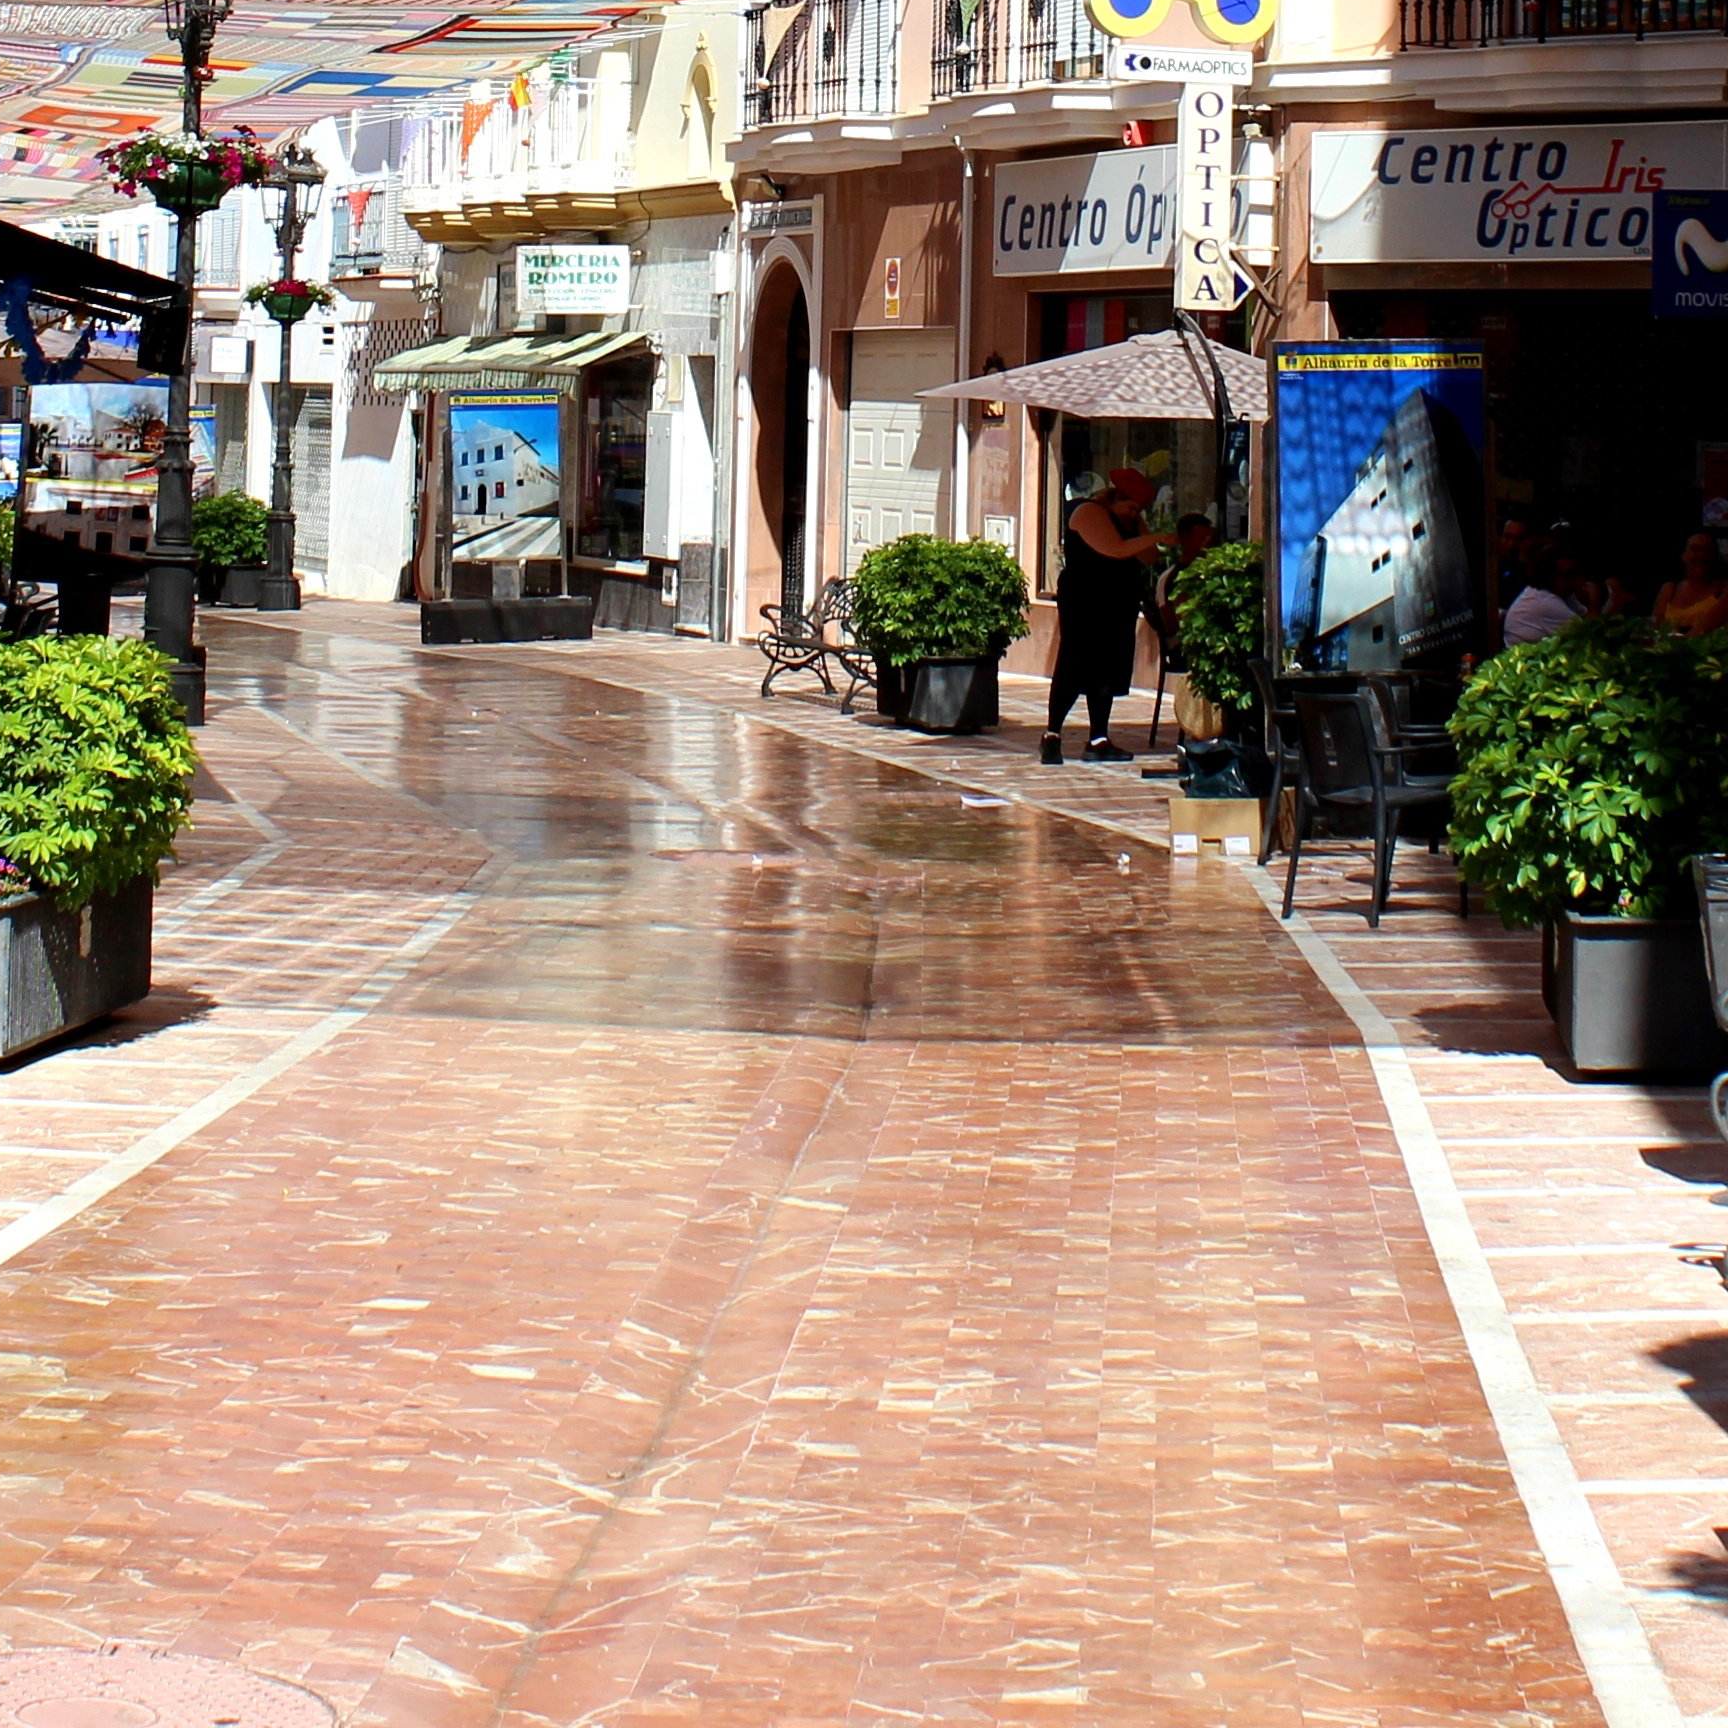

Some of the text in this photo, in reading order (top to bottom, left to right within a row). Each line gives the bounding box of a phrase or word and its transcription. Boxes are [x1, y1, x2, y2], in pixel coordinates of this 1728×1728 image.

[1153, 57, 1247, 75] FARMAOPTICS
[1378, 137, 1568, 185] Centro
[1604, 139, 1668, 193] Iris
[1192, 91, 1224, 301] OPTICA
[999, 193, 1107, 252] Centro
[528, 271, 618, 285] ROMERO
[1303, 355, 1451, 369] Alhaurín de la Torre
